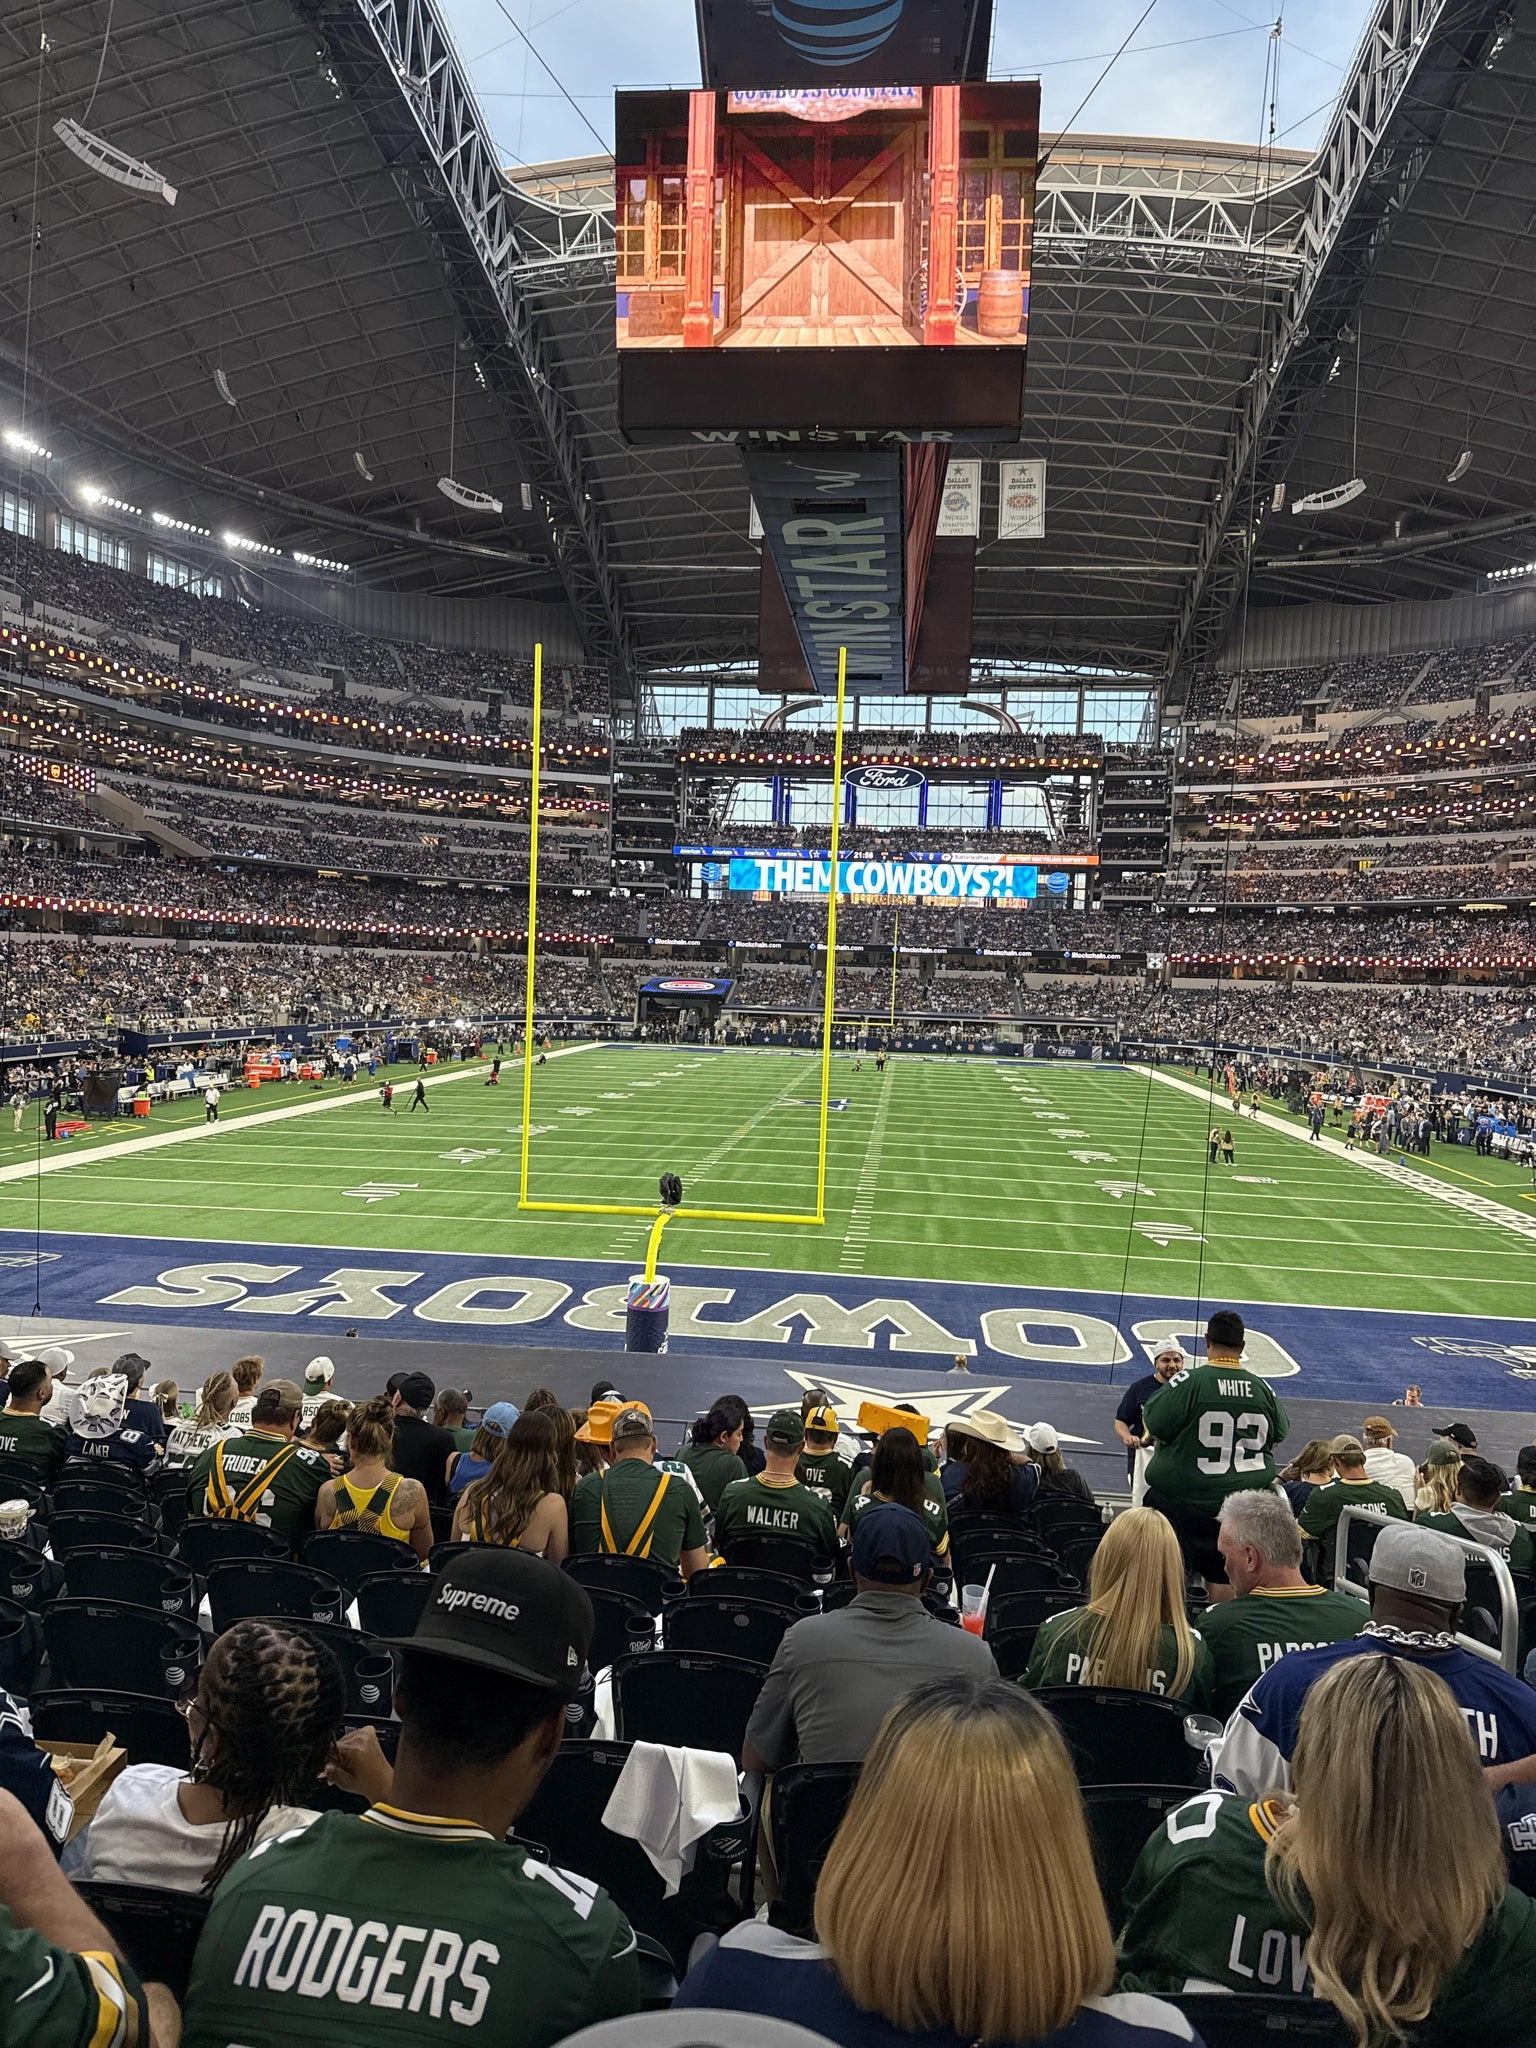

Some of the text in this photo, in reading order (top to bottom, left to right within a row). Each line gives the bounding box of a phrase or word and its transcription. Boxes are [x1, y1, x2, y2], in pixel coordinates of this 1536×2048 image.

[691, 429, 955, 443] WINSTAR
[781, 516, 892, 672] WINSTAR
[860, 768, 910, 787] Ford
[755, 859, 1014, 897] THEM COWBOYS?!
[655, 938, 701, 946] Blockchain.com
[735, 940, 782, 949] Blockchain.com
[899, 946, 947, 954] Blockchain.com
[983, 949, 1032, 957] Blockchain.com
[1071, 952, 1121, 960] Blockchain.com
[98, 1261, 1302, 1379] COWBOYS
[1217, 1378, 1253, 1398] WHITE
[229, 1412, 250, 1423] COBS
[0, 1435, 18, 1452] OVE
[171, 1429, 213, 1448] MATTHEWS
[1197, 1410, 1269, 1475] 92
[82, 1440, 110, 1458] LAMB
[221, 1454, 268, 1475] TRUDEA
[806, 1467, 826, 1483] OVE
[746, 1505, 799, 1530] WALKER
[437, 1581, 521, 1622] Supreme
[1228, 1914, 1311, 1994] LOV
[233, 1904, 500, 2027] RODGERS
